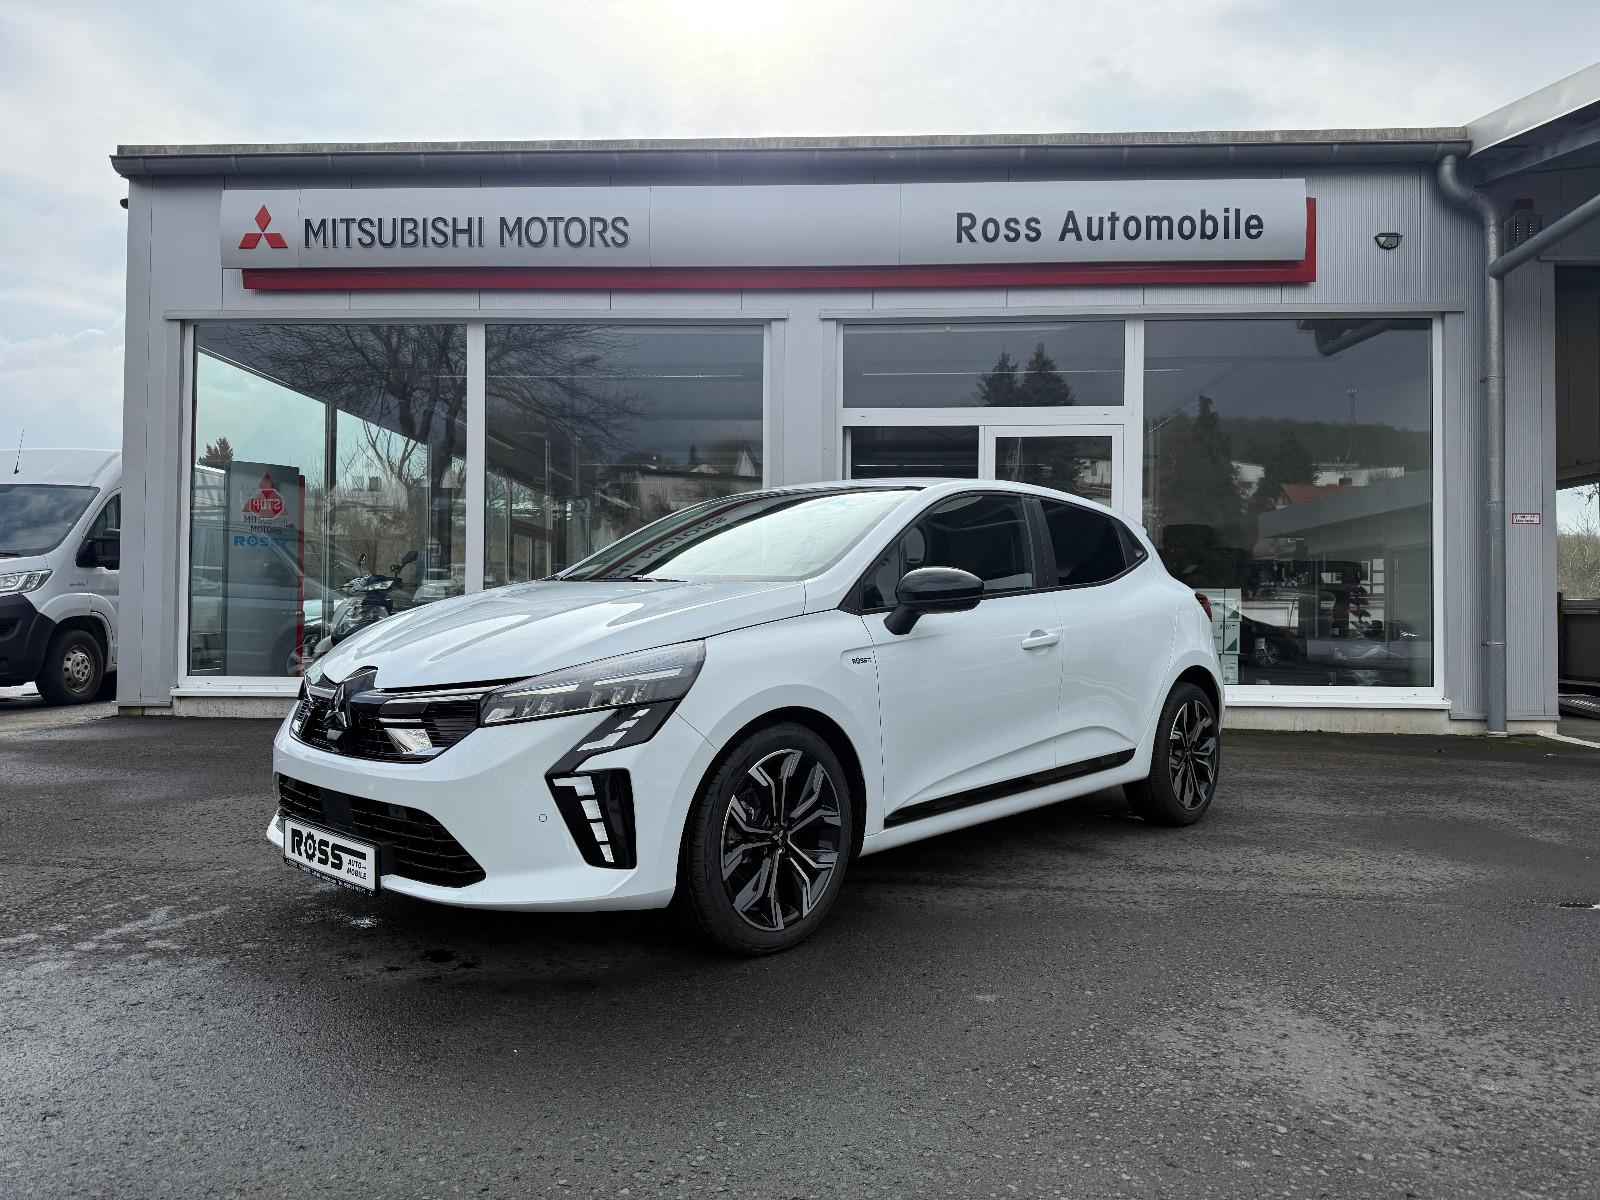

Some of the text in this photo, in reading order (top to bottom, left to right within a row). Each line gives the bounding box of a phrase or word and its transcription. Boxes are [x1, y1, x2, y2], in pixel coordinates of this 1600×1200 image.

[304, 216, 631, 249] MITSUBISHI MOTORS
[956, 208, 1264, 243] Ross Automobile
[291, 828, 366, 870] ROSS
